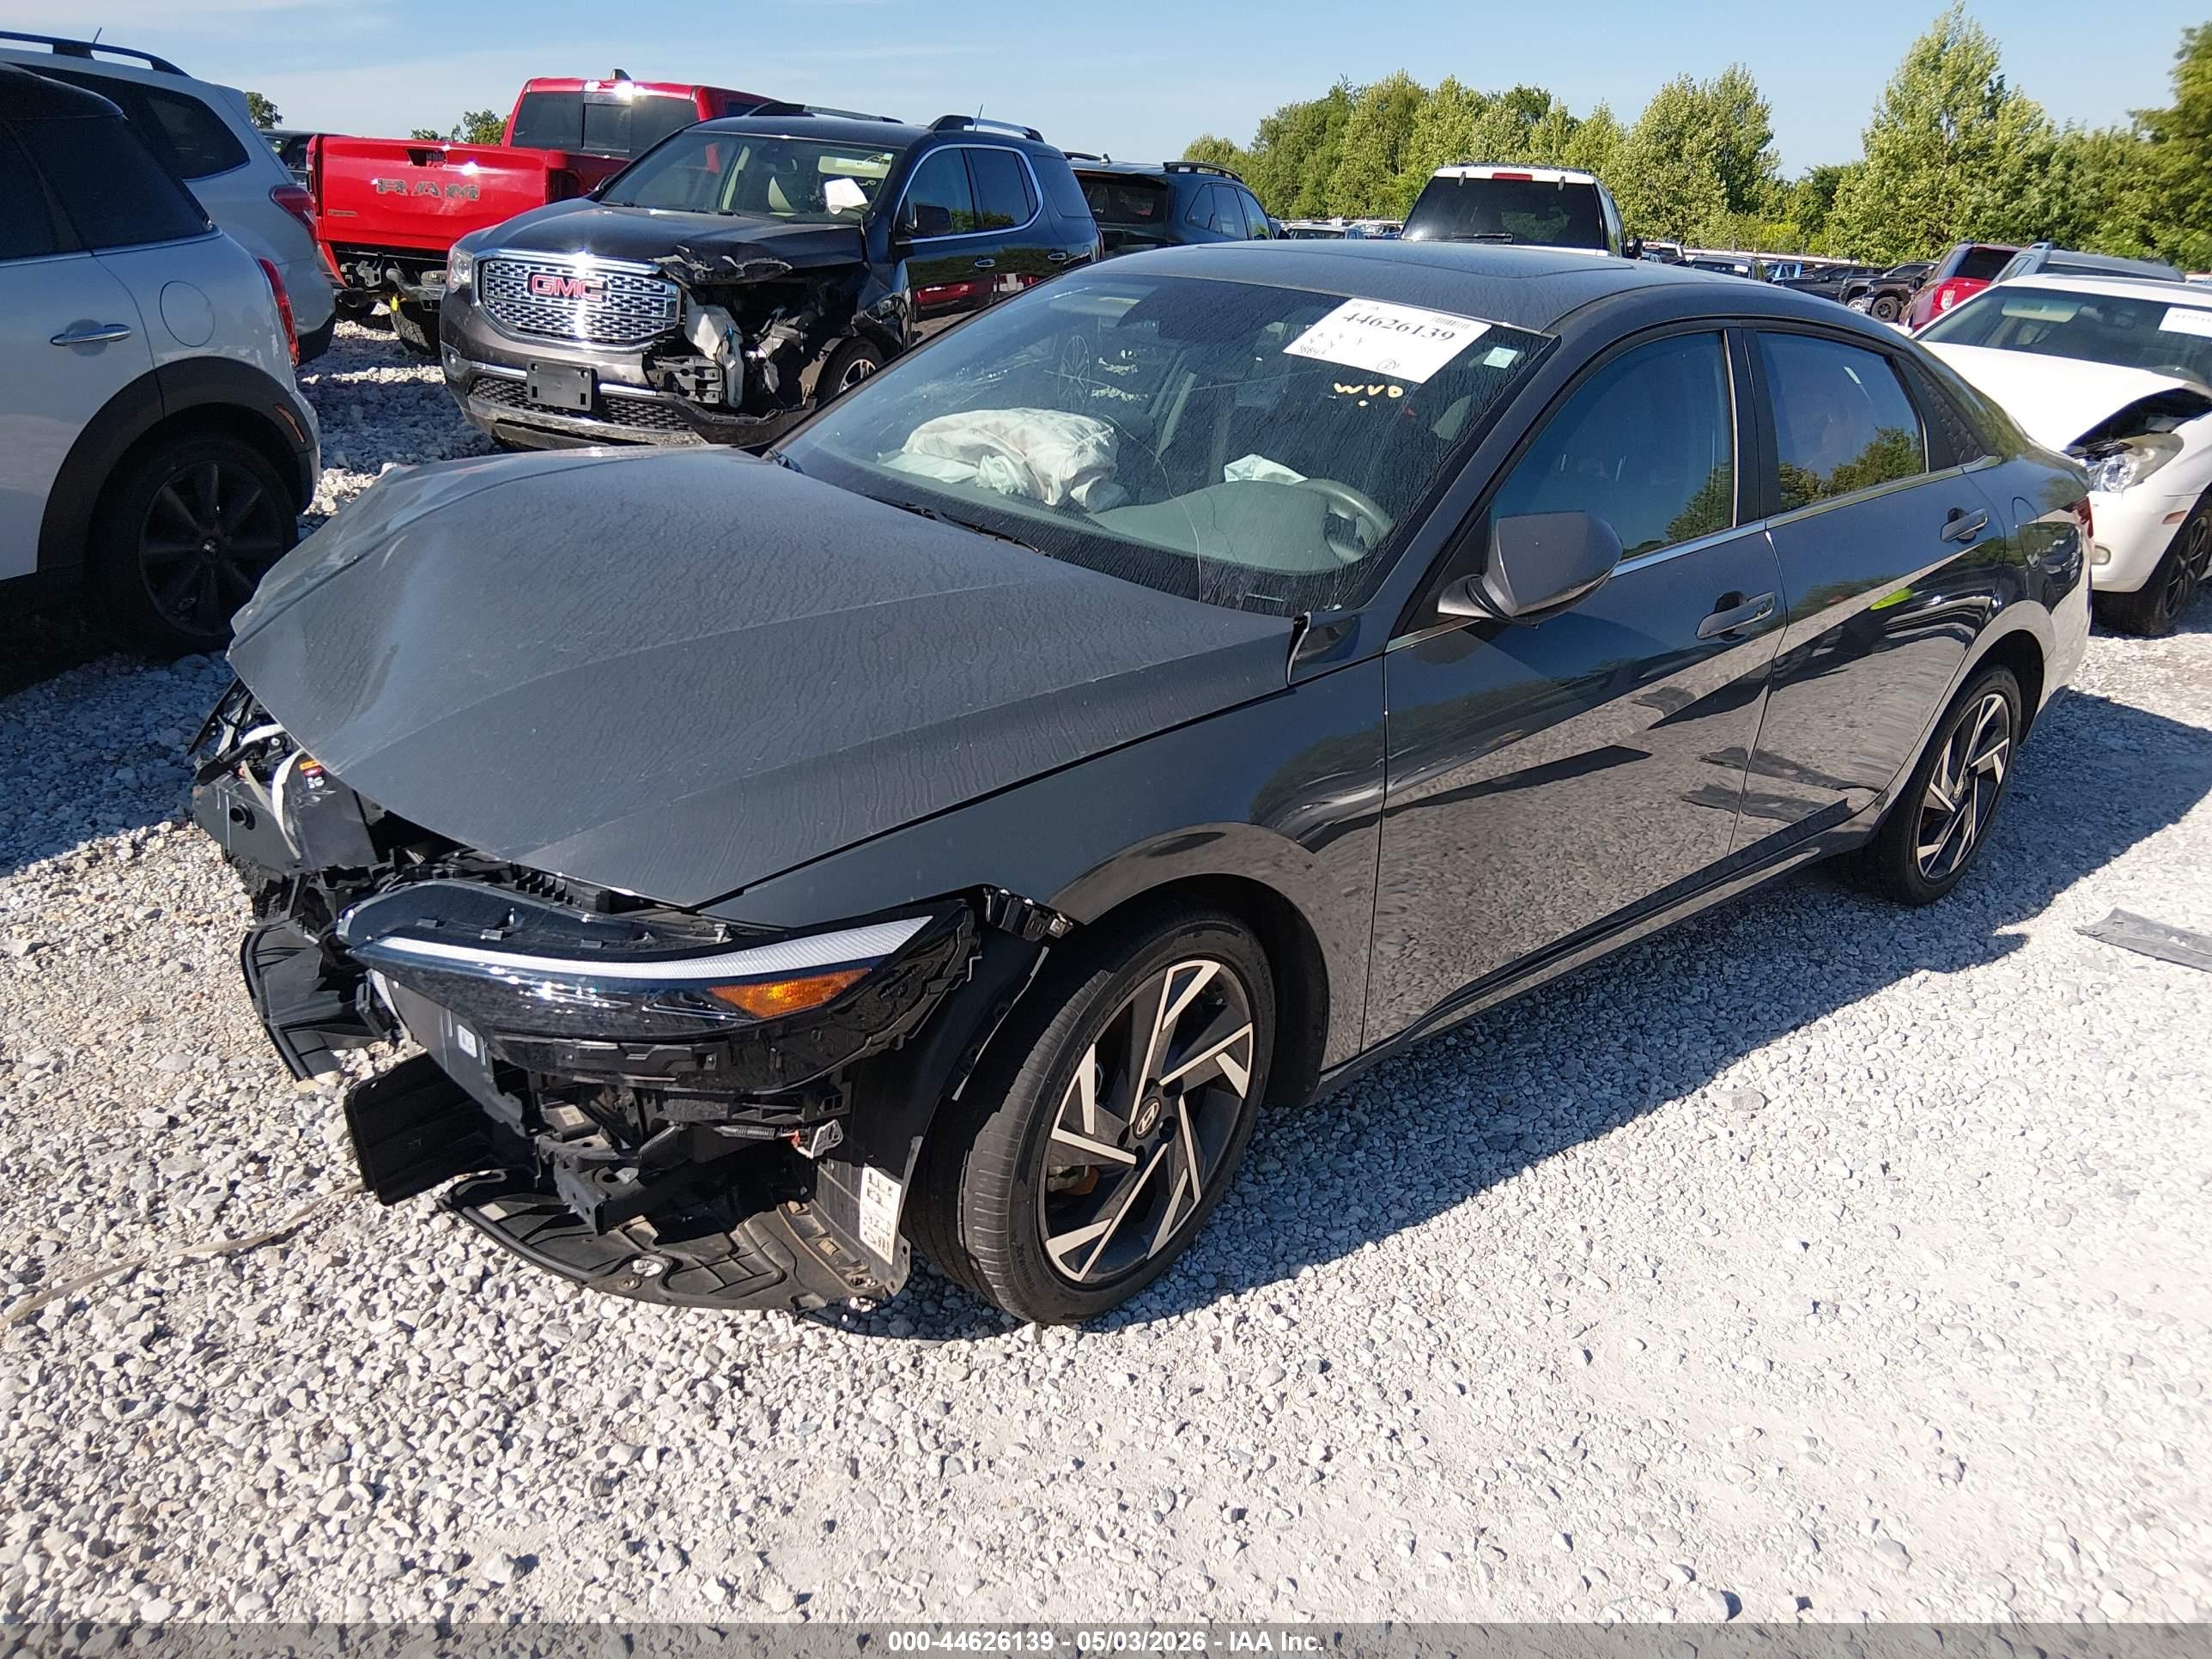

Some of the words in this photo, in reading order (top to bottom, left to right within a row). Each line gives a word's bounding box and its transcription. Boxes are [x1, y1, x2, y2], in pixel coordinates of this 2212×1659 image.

[374, 179, 480, 200] RAM
[532, 274, 604, 301] GMC
[1342, 312, 1456, 342] 44626139
